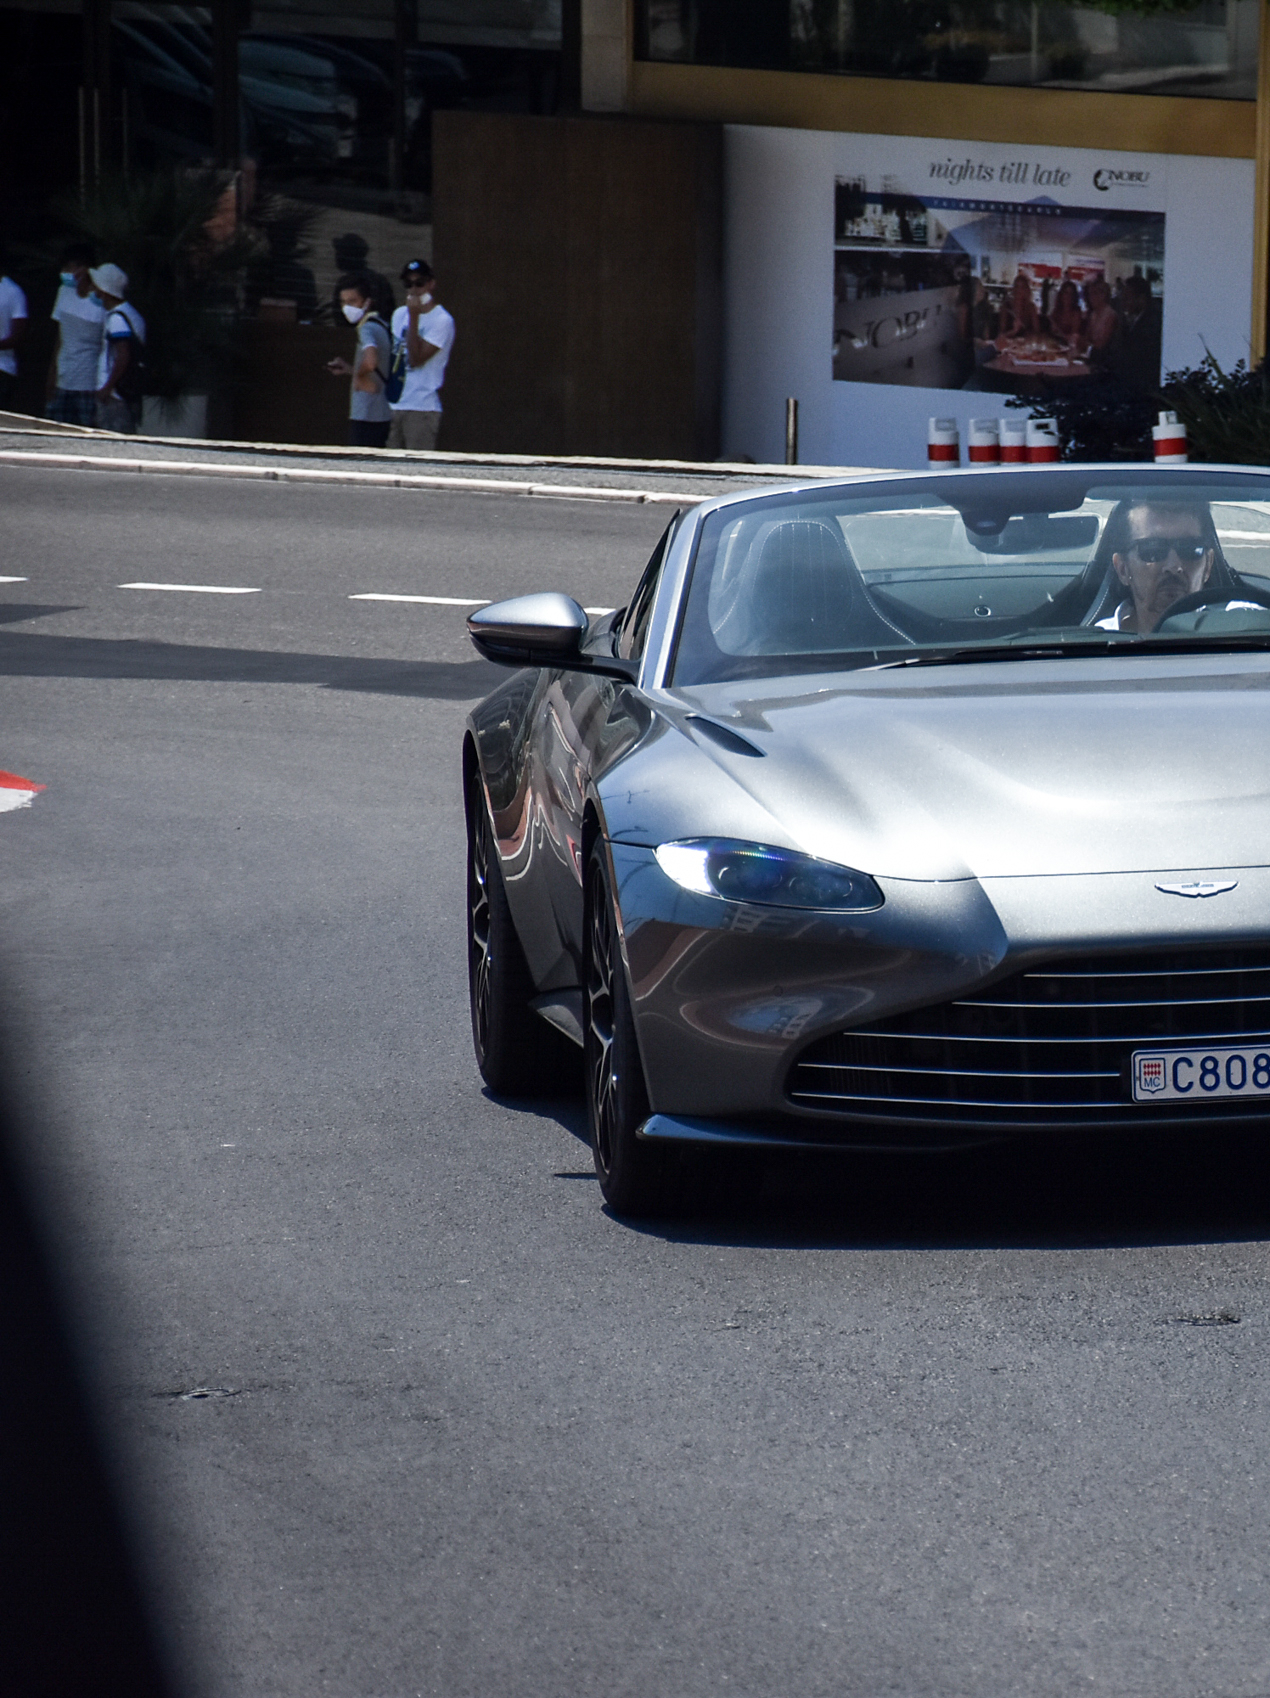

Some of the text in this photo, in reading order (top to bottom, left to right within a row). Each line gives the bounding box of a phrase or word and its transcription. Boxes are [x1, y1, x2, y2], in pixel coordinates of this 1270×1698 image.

[928, 157, 1072, 188] nights till late
[1108, 169, 1151, 183] NOBU
[1143, 1077, 1161, 1088] MC
